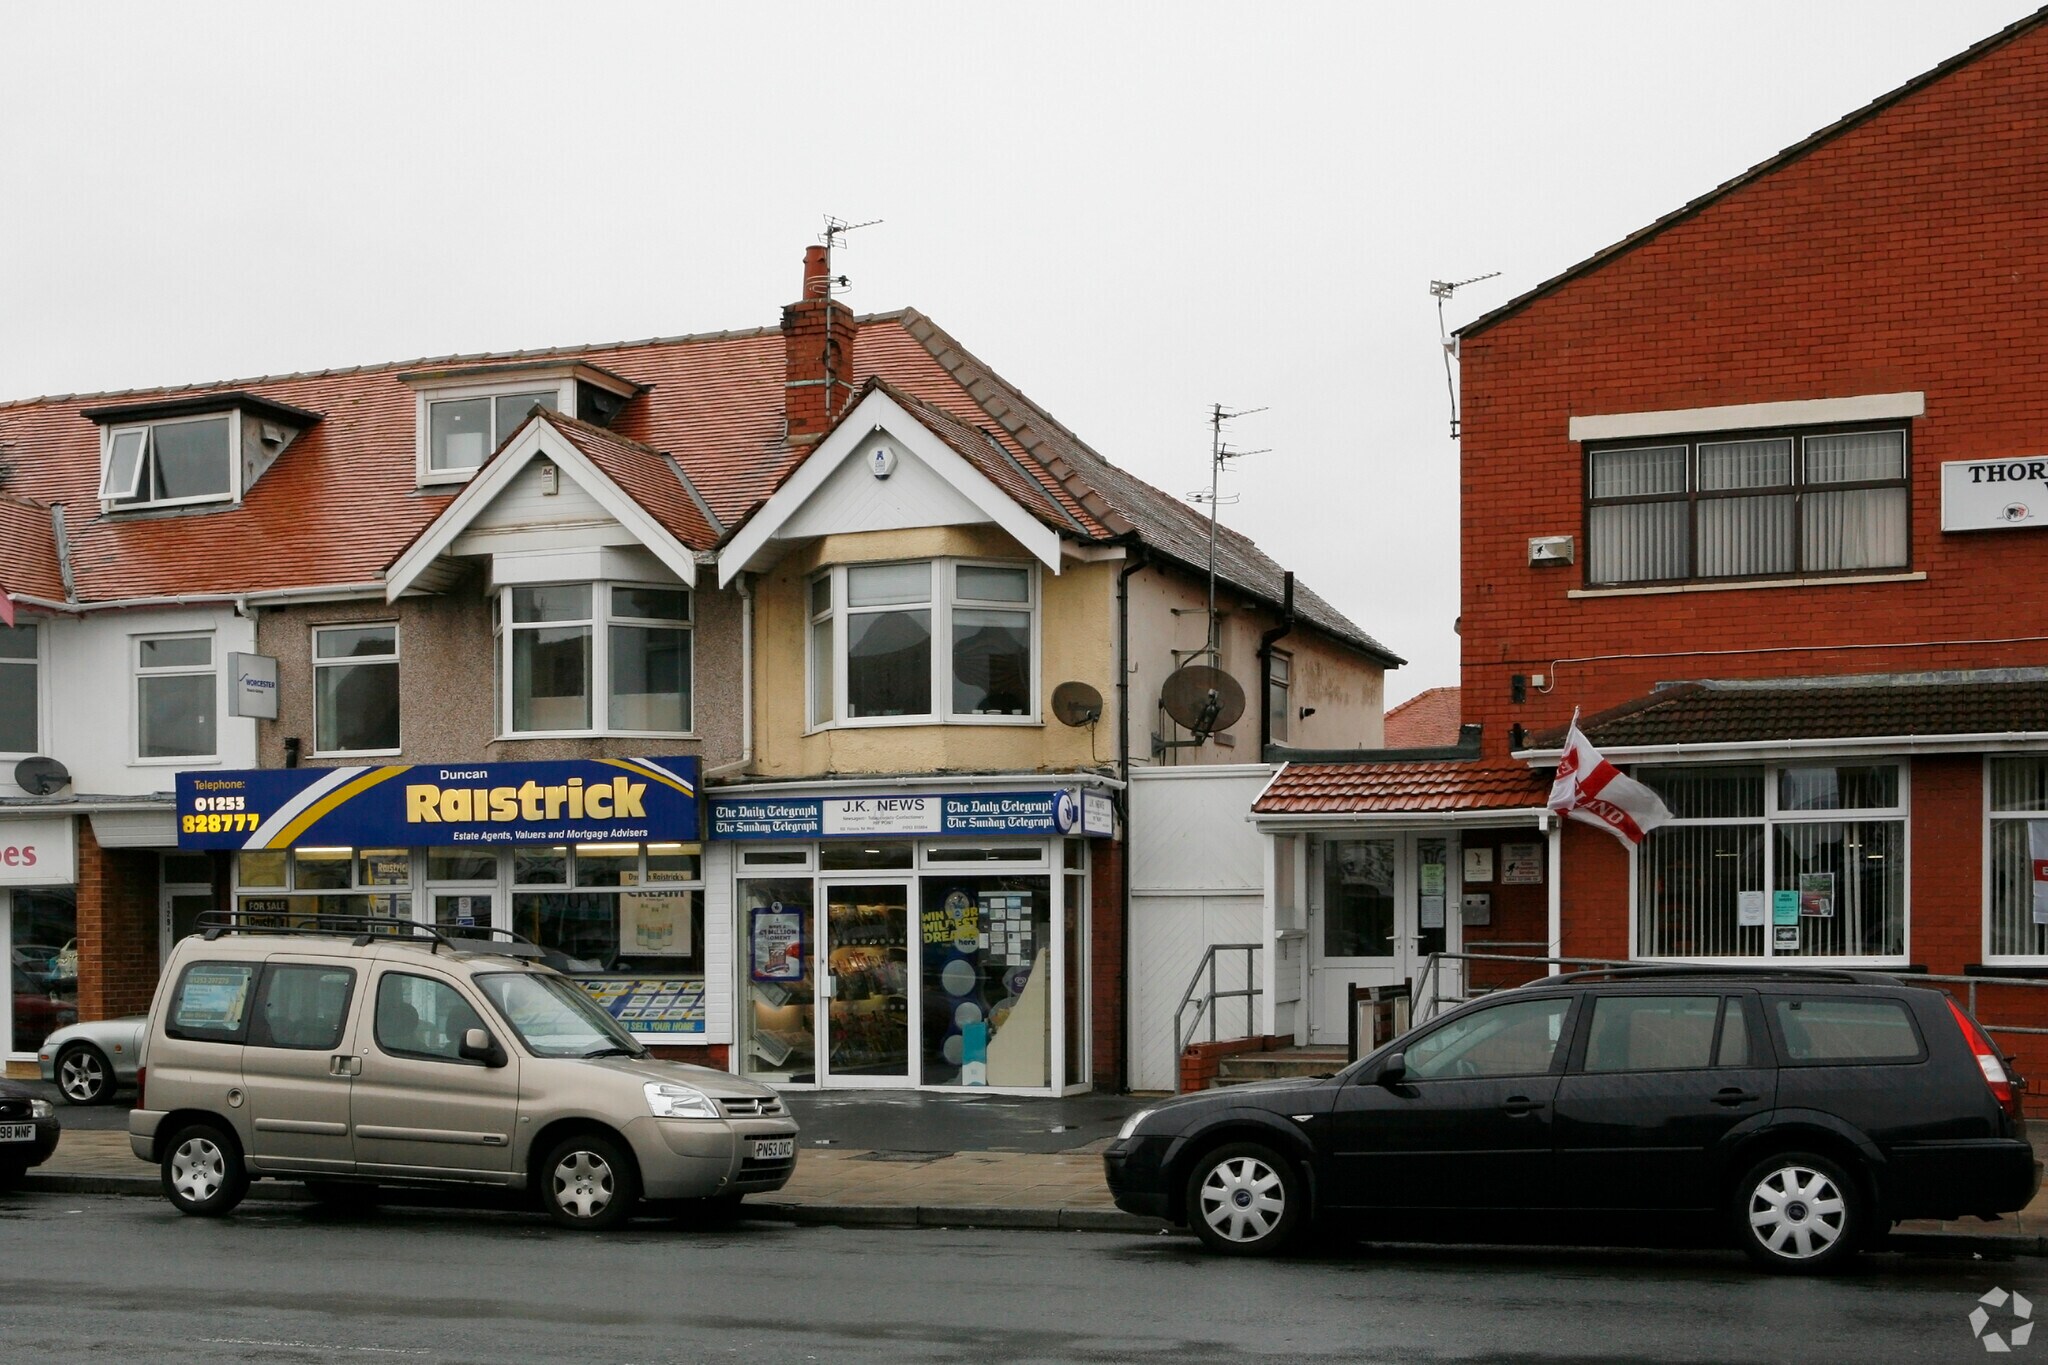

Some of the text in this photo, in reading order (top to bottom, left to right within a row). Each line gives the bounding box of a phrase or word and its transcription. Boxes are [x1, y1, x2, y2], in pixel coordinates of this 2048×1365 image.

[1968, 462, 2048, 483] THOR
[245, 679, 275, 688] WORCESTER
[440, 769, 488, 780] Duncan
[194, 780, 245, 791] Telephone:
[194, 796, 246, 811] 01253
[406, 776, 648, 824] Raistrick
[842, 798, 925, 812] J.K. NEWS
[947, 801, 969, 813] The
[970, 800, 1000, 814] Daily
[716, 805, 818, 819] The Daily Telegraph
[182, 813, 259, 833] 828777
[716, 820, 818, 834] The Sunday Telegraph
[947, 817, 967, 829] The
[968, 817, 1006, 830] Sunday
[453, 828, 648, 842] Estate Agents, Valuers and Mortgage Advisers
[0, 846, 37, 867] es
[249, 901, 286, 911] FOR SALE
[922, 910, 944, 922] WIN
[959, 938, 976, 946] here
[630, 1022, 649, 1031] SELL
[650, 1022, 671, 1031] YOUR
[671, 1022, 695, 1031] HOME
[756, 1142, 778, 1157] PN53
